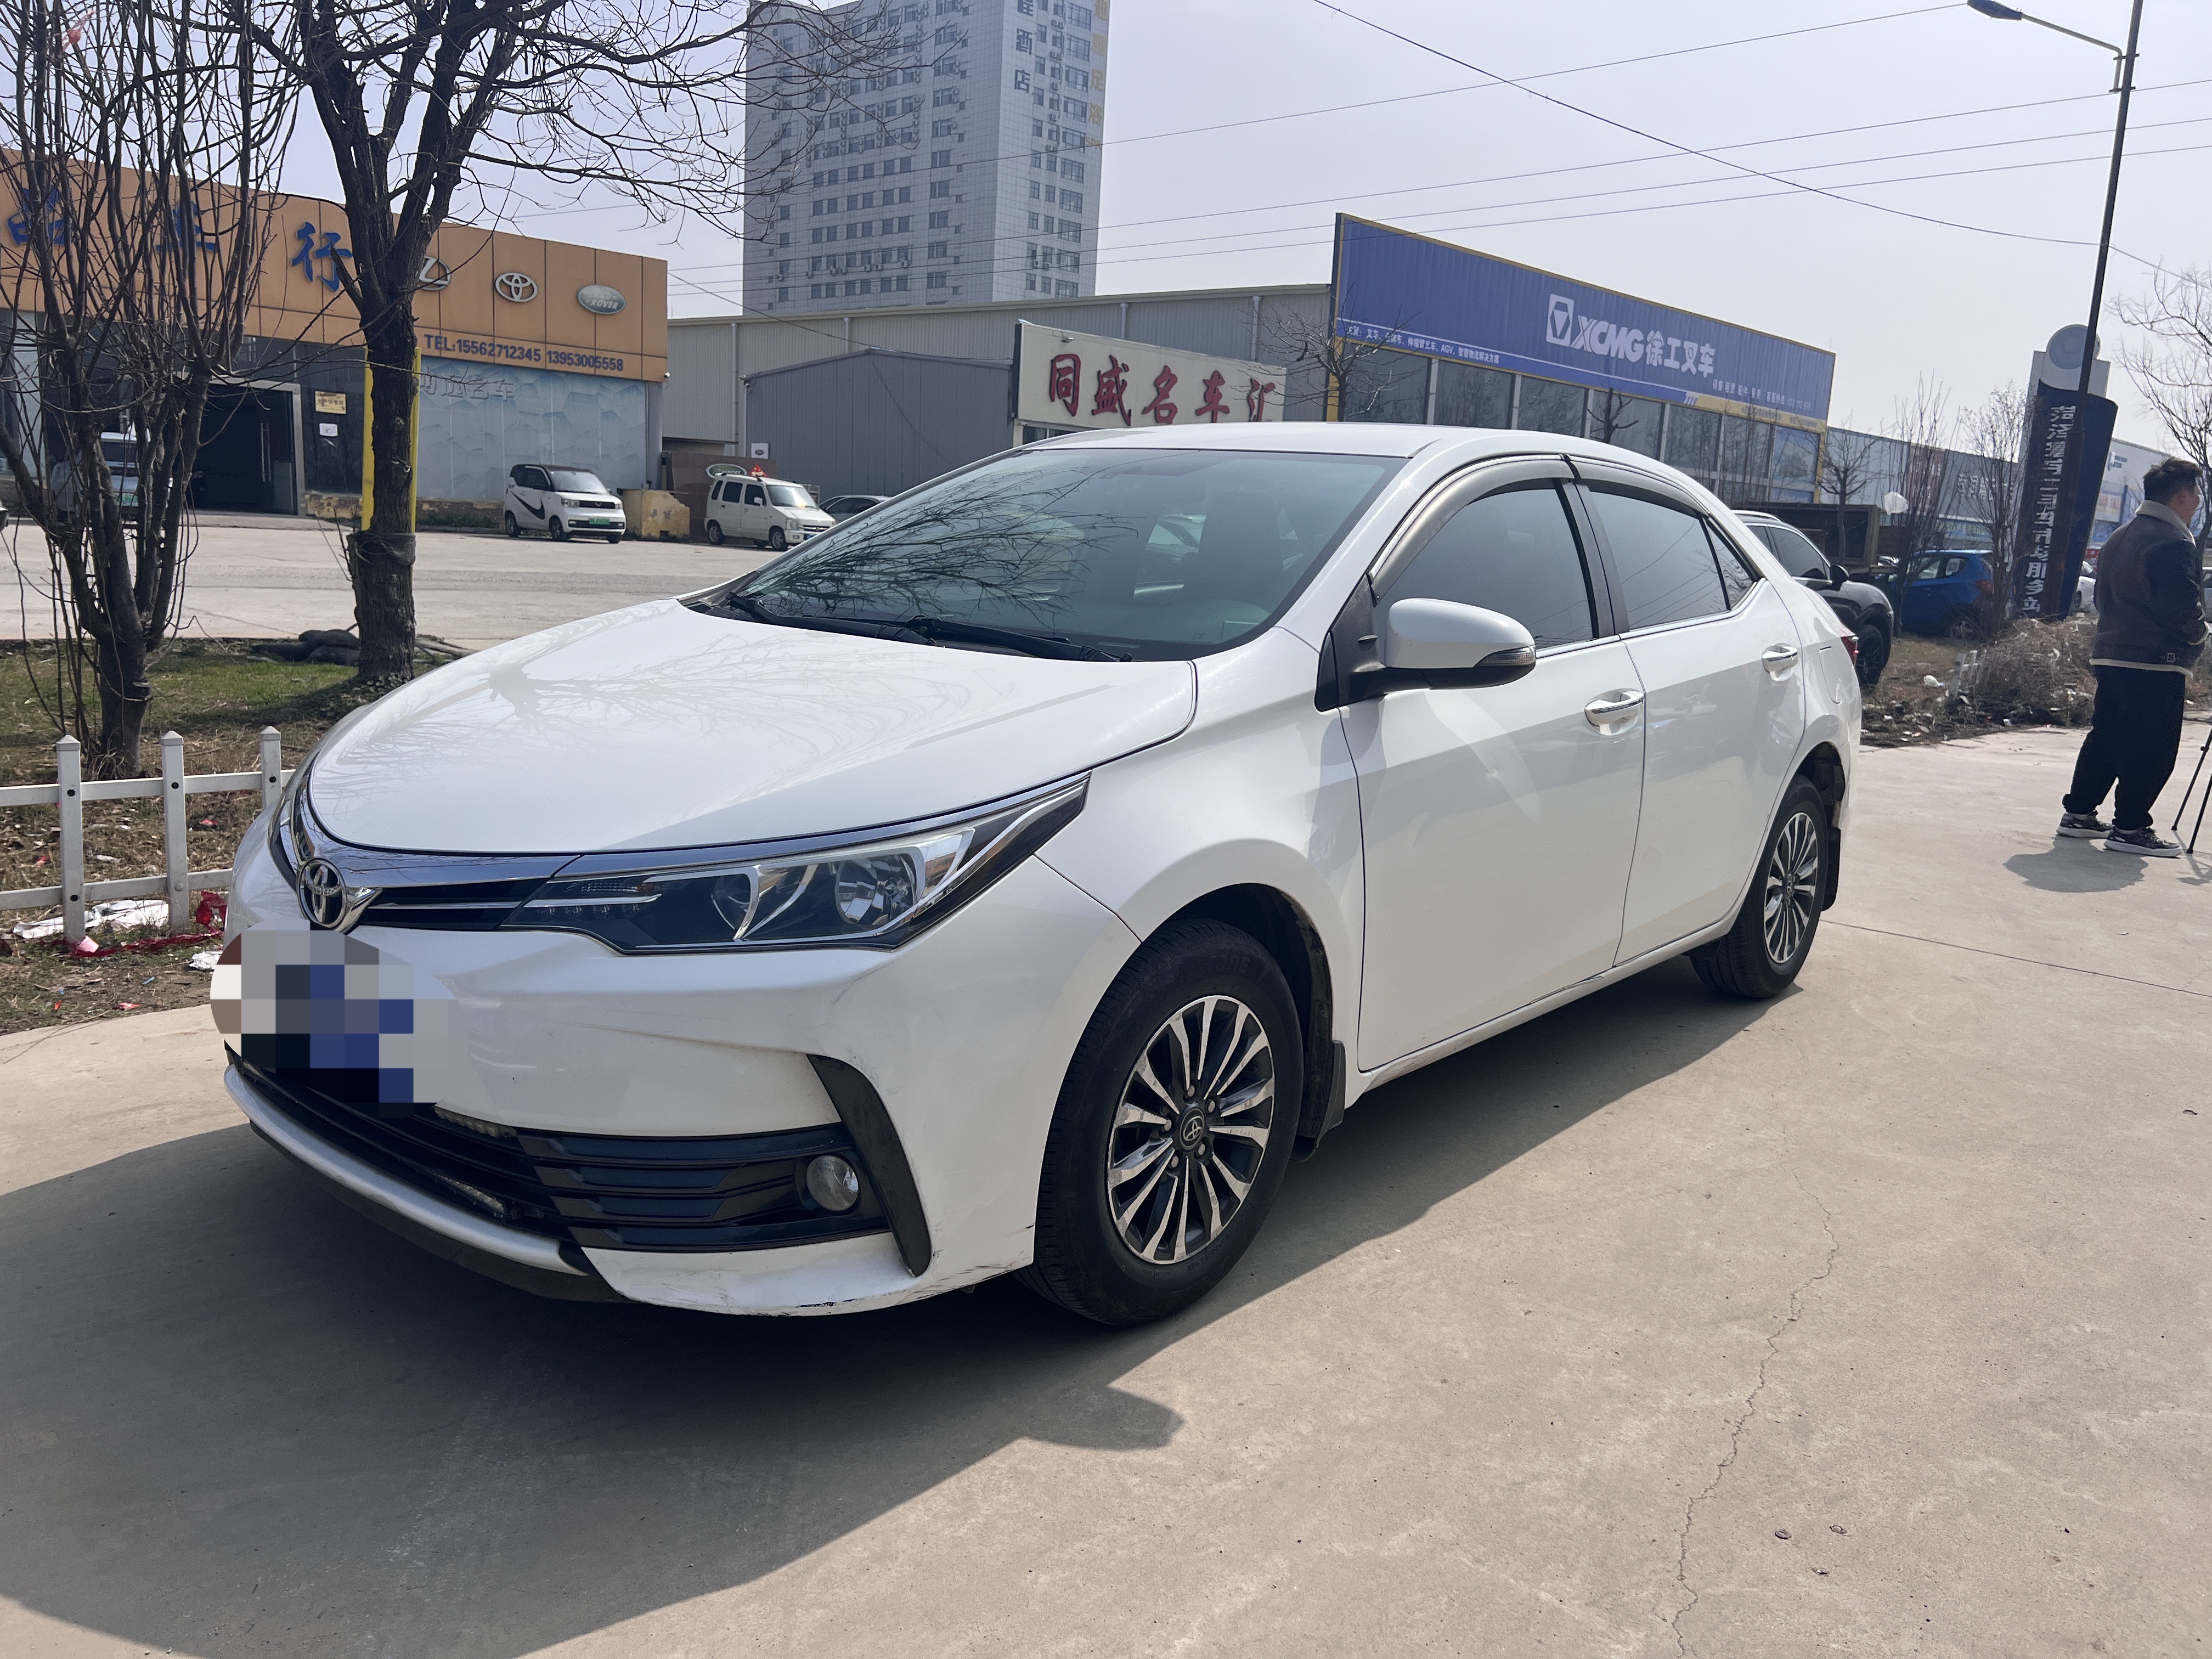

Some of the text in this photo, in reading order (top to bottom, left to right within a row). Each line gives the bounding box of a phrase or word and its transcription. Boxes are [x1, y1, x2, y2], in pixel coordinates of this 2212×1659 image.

[590, 299, 619, 309] ROVER
[424, 334, 624, 371] TEL:15562712345 13953005558
[1570, 315, 1716, 378] XCMG 徐工叉车
[1049, 354, 1276, 426] 同盛名车汇
